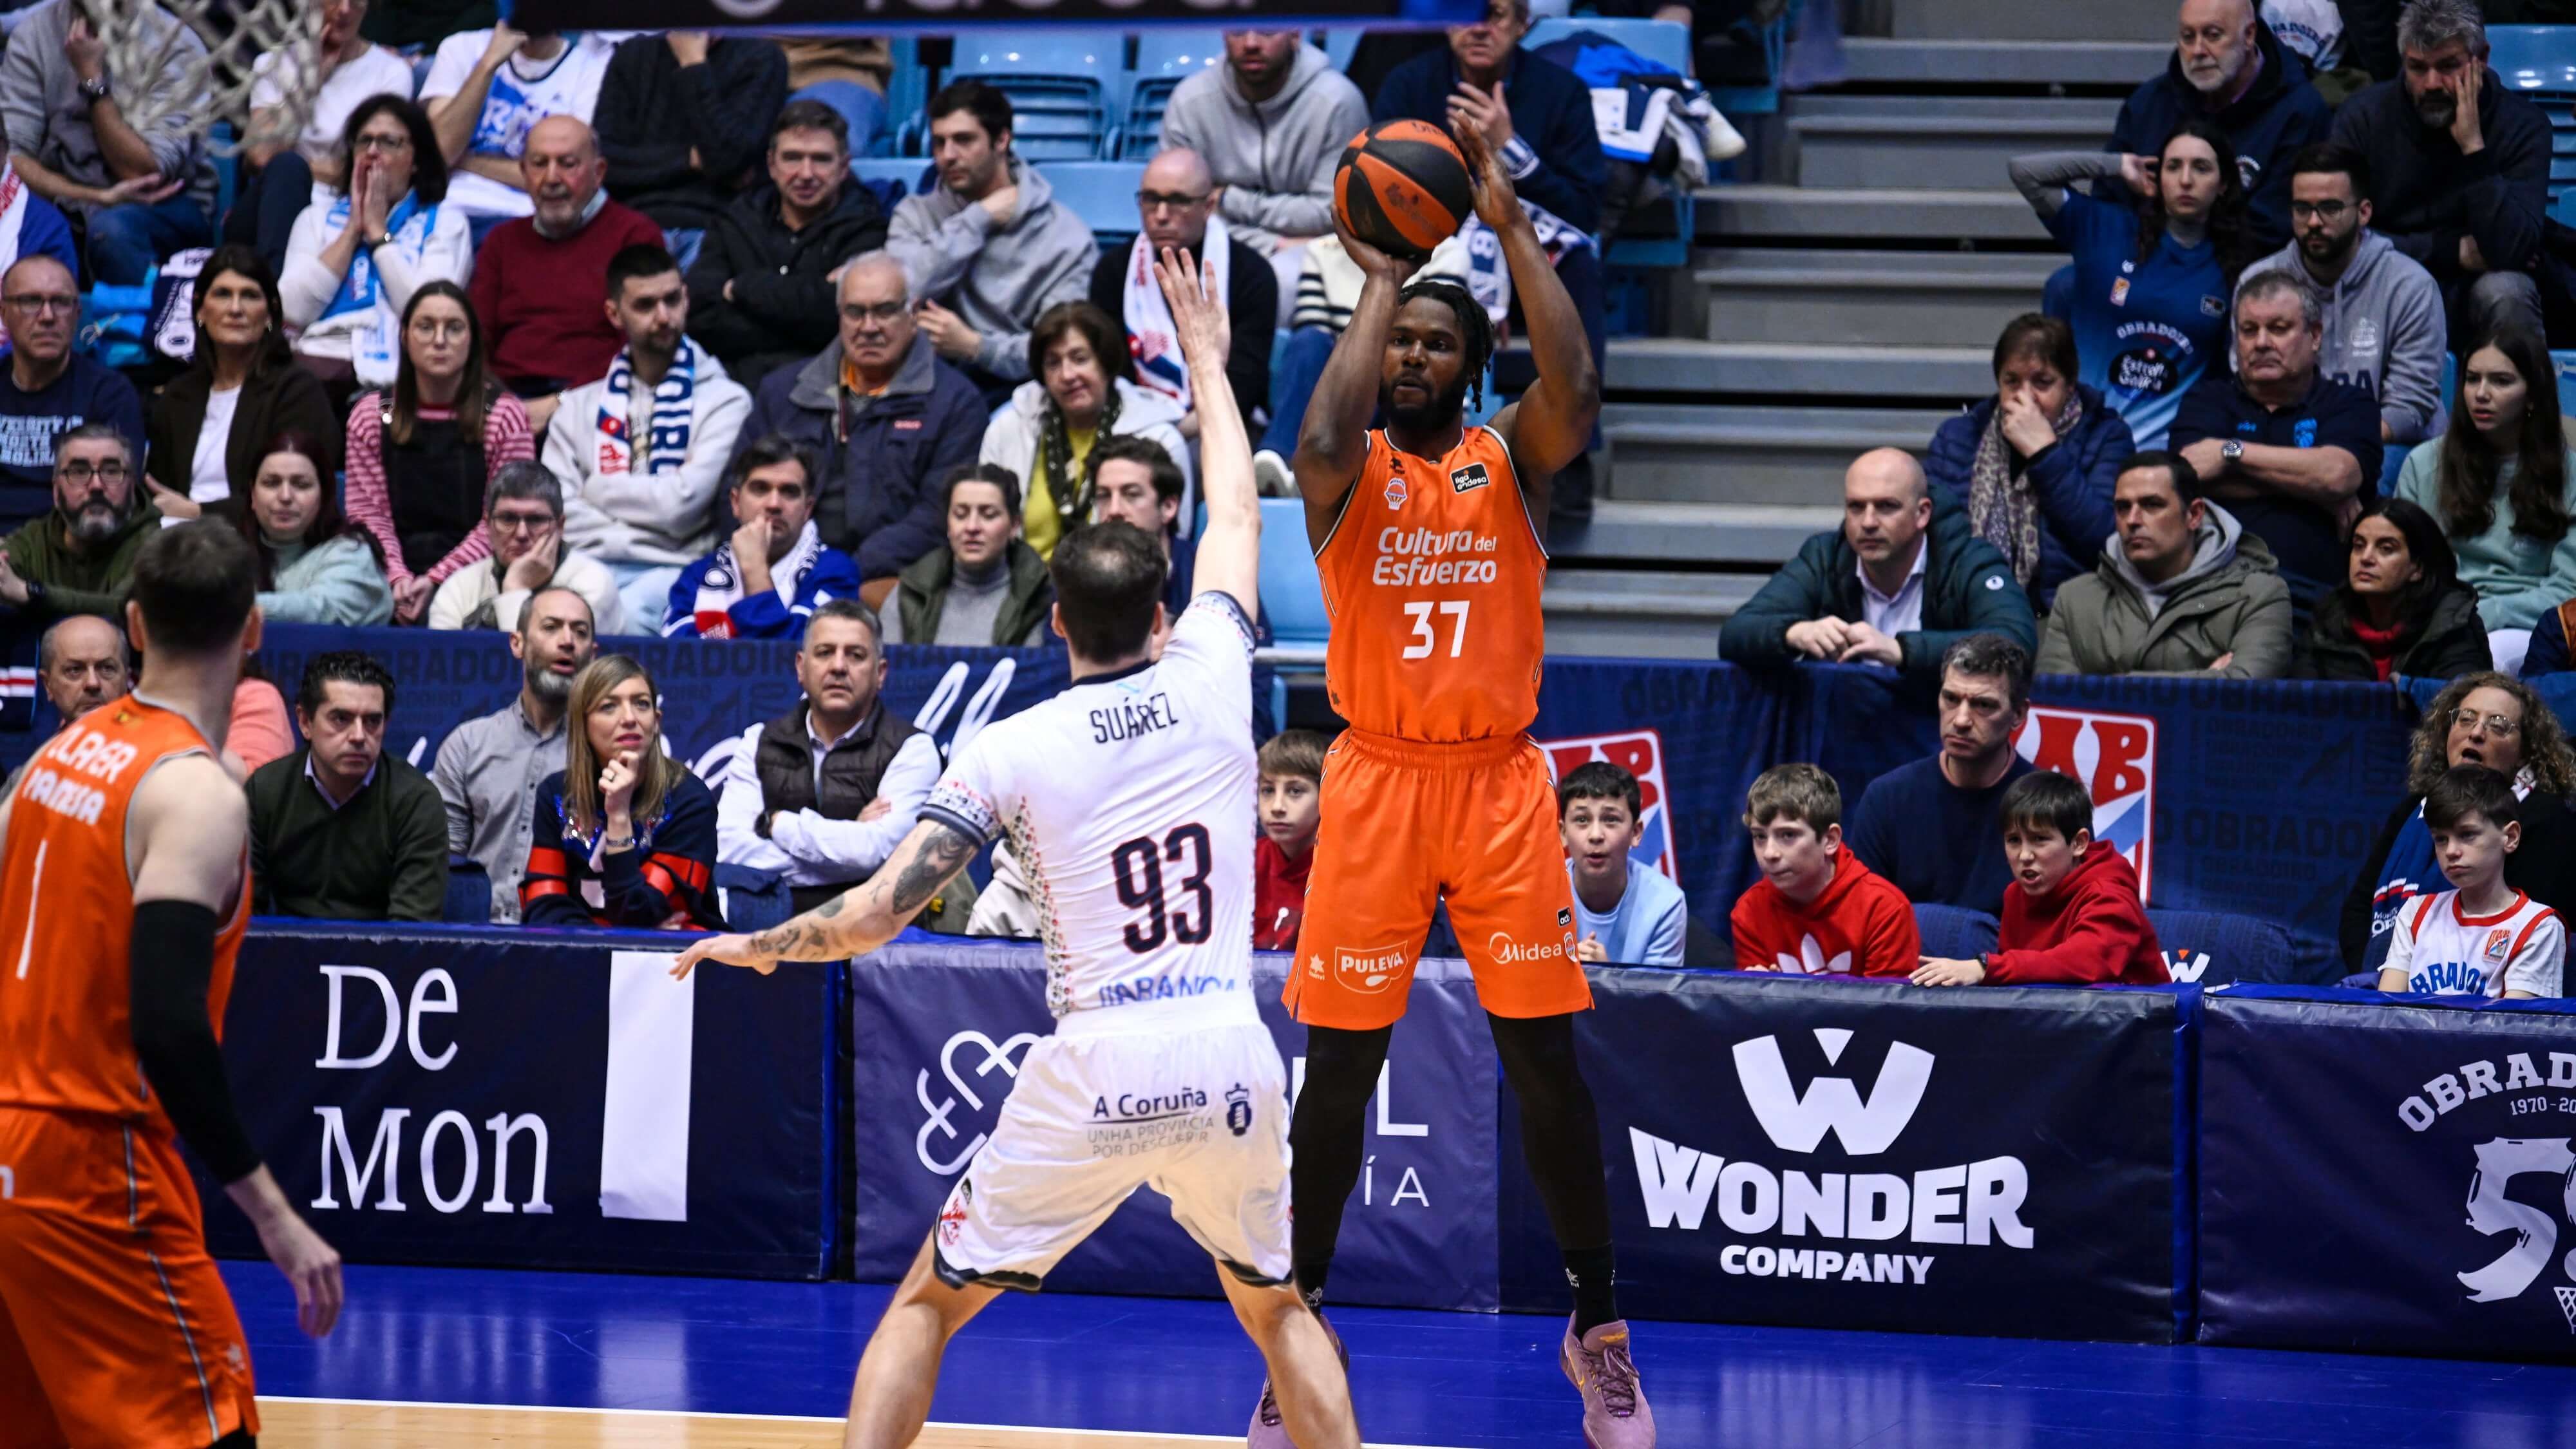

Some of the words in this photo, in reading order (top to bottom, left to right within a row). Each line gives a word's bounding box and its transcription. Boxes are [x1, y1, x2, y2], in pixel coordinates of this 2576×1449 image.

[1455, 475, 1470, 485] liga
[1457, 476, 1487, 491] endesa
[1378, 526, 1473, 556] Cultura
[1475, 536, 1497, 552] del
[1372, 556, 1497, 587] Esfuerzo
[1402, 600, 1470, 659] 37
[1089, 692, 1179, 744] SUÁREZ
[1111, 822, 1212, 954] 93
[16, 838, 48, 980] 1
[1341, 952, 1404, 973] PULEVA
[1499, 942, 1562, 961] Midea
[315, 965, 459, 1071] De
[1093, 1096, 1109, 1118] A
[1118, 1087, 1207, 1117] Coruña
[2398, 1052, 2576, 1132] OBRAD
[1087, 1126, 1132, 1144] UNHA
[1093, 1144, 1123, 1158] POR
[311, 1106, 553, 1214] Mon
[1629, 1126, 2034, 1249] WONDER
[1720, 1244, 1935, 1285] COMPANY
